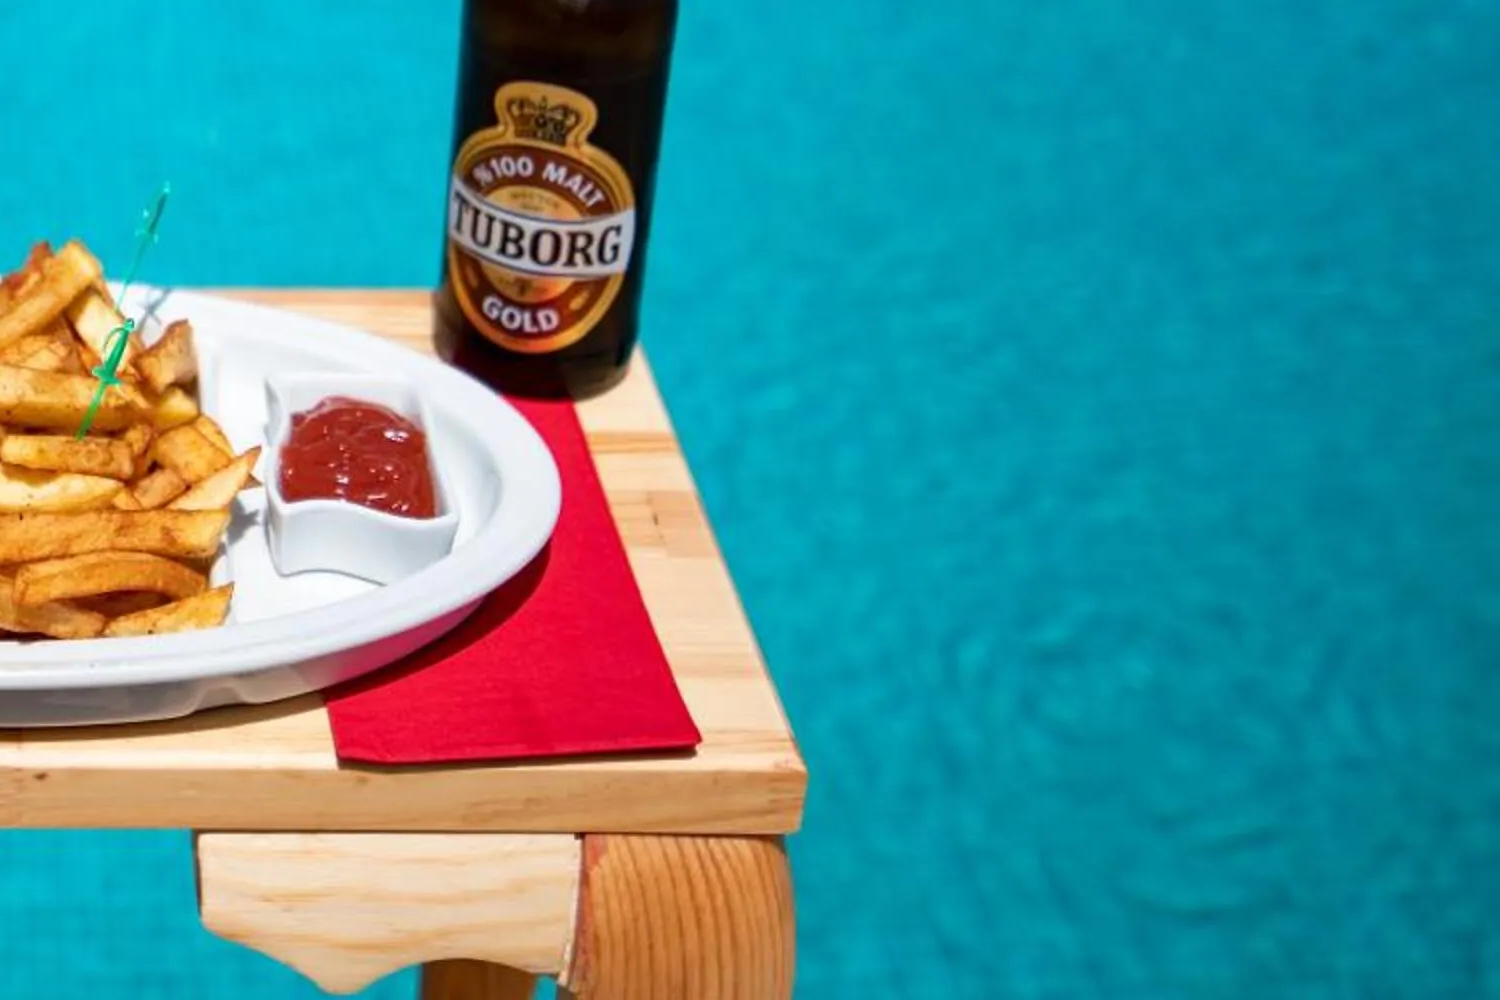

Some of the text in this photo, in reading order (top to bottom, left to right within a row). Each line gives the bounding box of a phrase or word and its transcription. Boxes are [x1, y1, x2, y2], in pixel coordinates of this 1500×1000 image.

[473, 156, 534, 185] %100
[542, 163, 605, 208] MALT
[452, 191, 623, 268] TUBORG
[481, 296, 560, 333] GOLD
